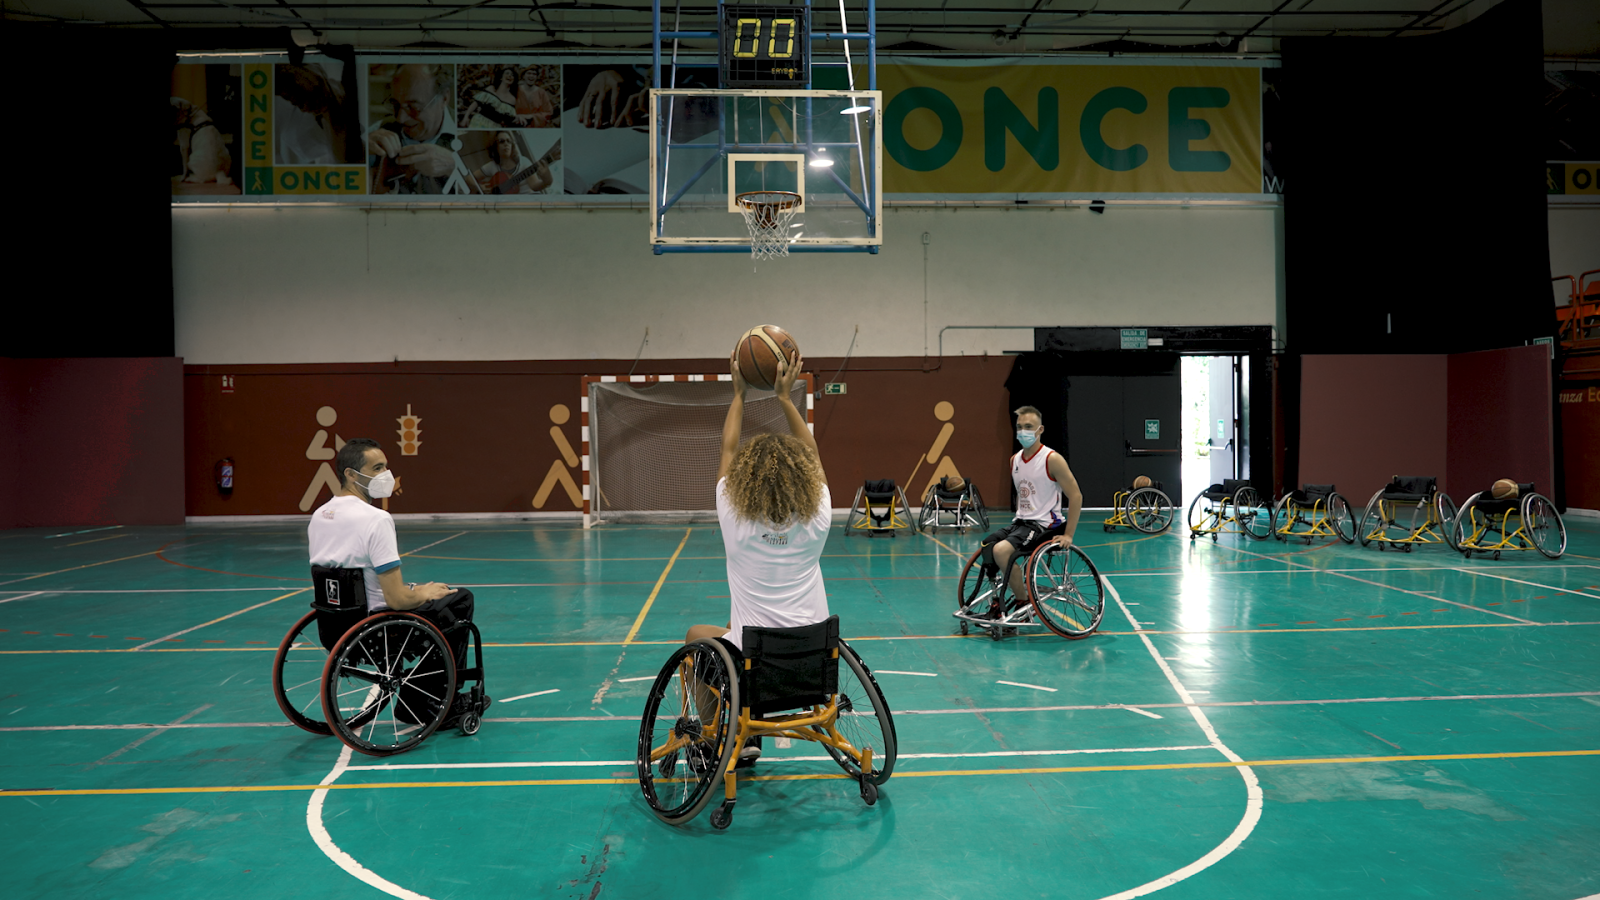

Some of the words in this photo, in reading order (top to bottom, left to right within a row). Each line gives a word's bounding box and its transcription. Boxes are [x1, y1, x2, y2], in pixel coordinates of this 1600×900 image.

[733, 18, 796, 58] 00
[249, 70, 268, 160] ONCE
[882, 86, 1231, 172] ONCE
[280, 170, 360, 190] ONCE
[1572, 168, 1600, 190] O
